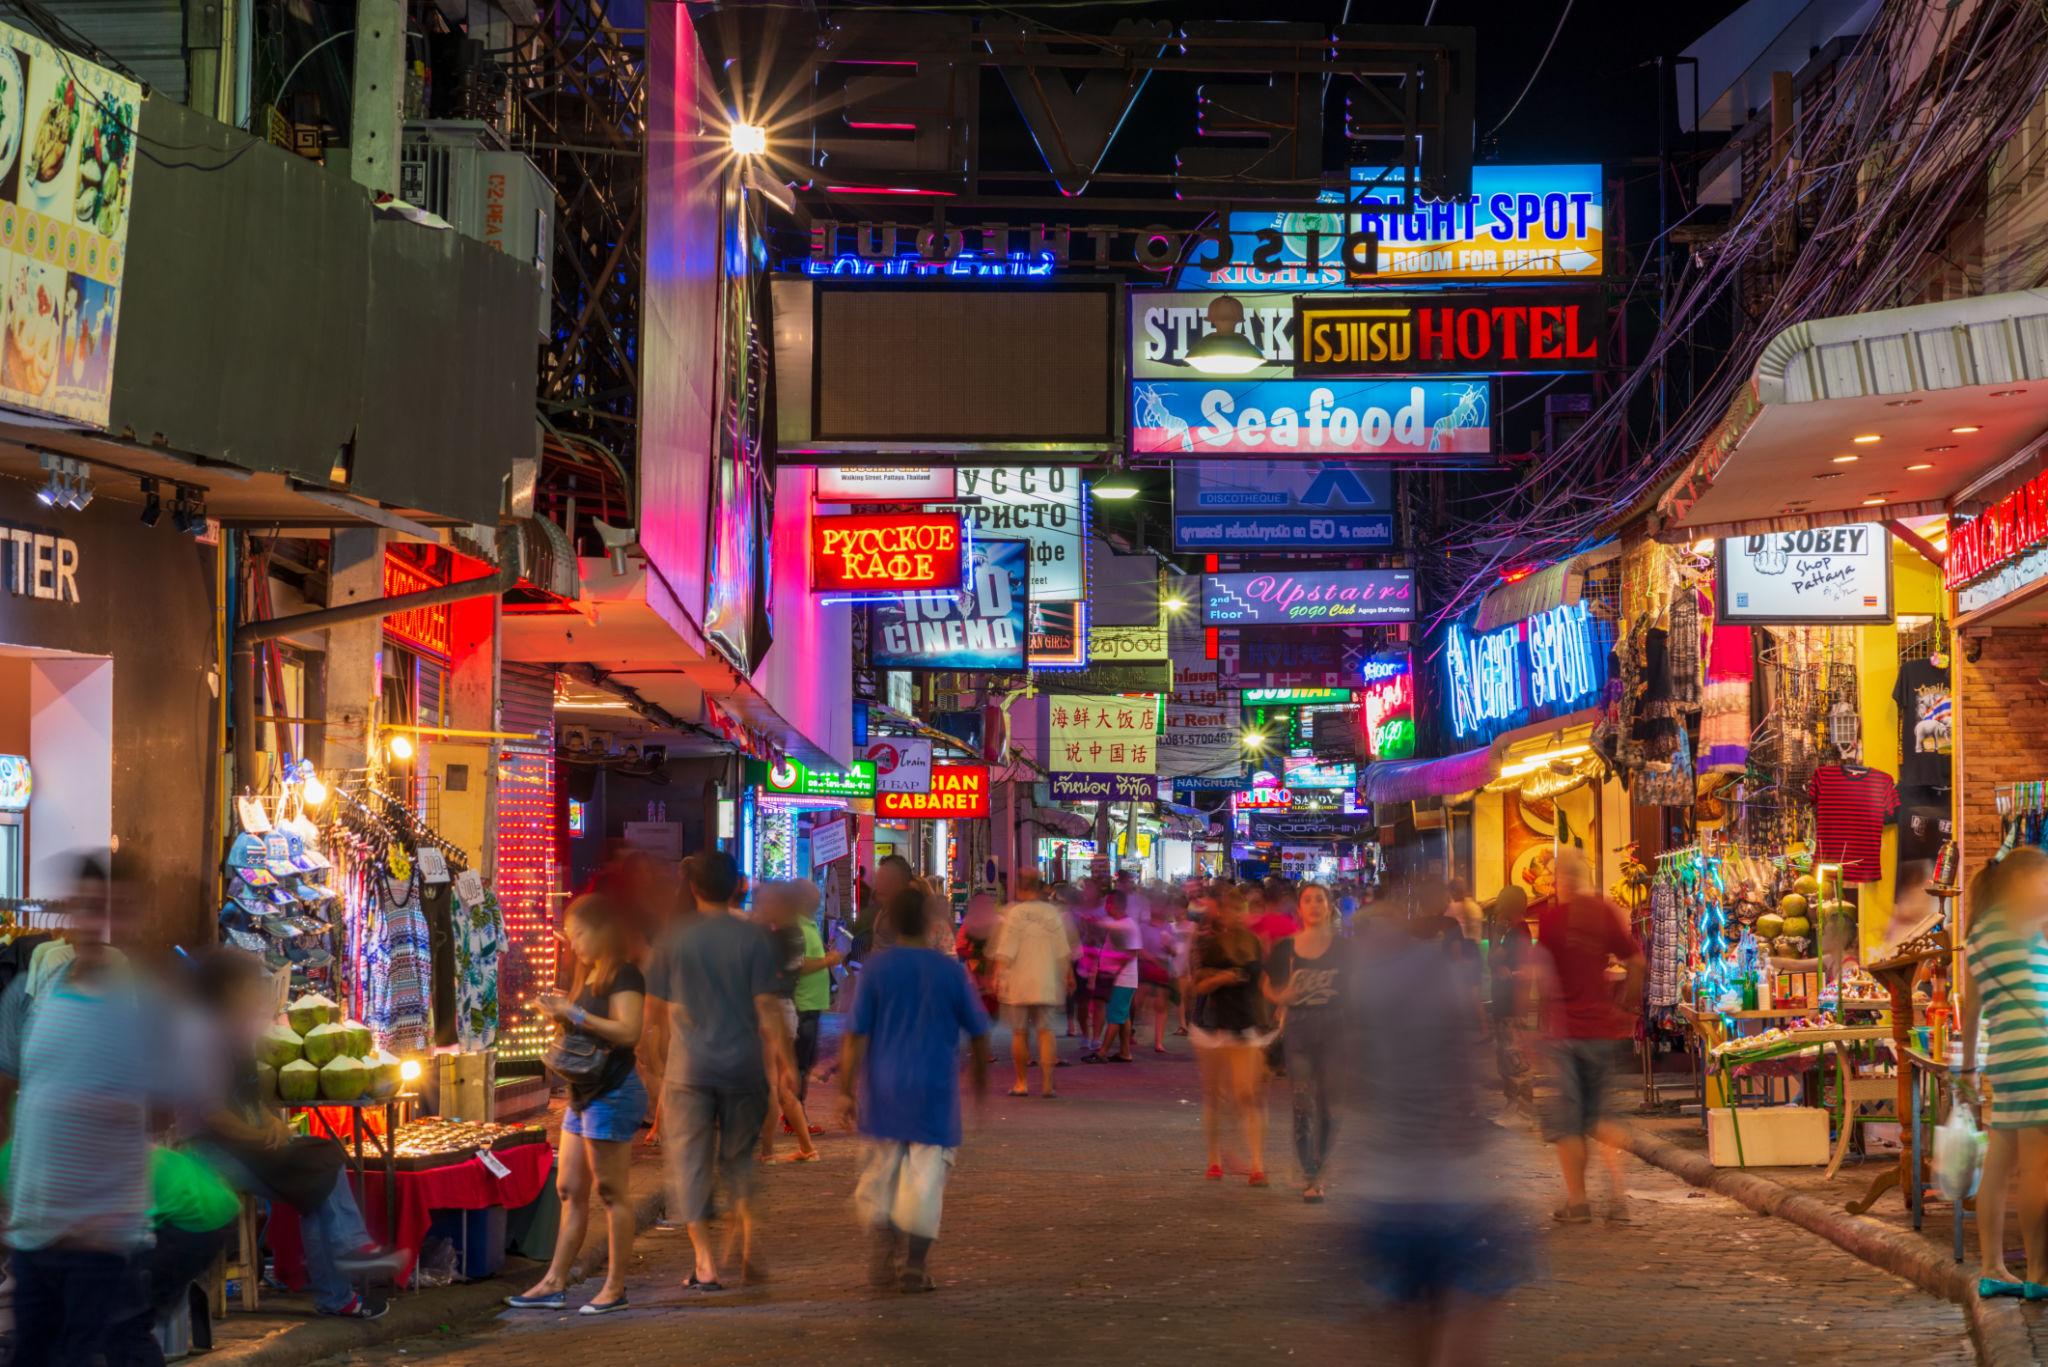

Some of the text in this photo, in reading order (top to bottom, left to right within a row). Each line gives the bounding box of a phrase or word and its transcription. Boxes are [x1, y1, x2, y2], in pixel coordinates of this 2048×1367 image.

[1361, 194, 1480, 241] RIGHT
[1489, 192, 1592, 240] SPOT
[1393, 249, 1558, 273] ROOM FOR RENT
[1418, 305, 1598, 360] HOTEL
[1198, 387, 1425, 447] Seafood
[1206, 493, 1282, 503] DISCOTHEQUE
[822, 525, 955, 554] РУССКОЕ
[1309, 519, 1336, 539] 50
[1339, 526, 1350, 538] %
[841, 553, 935, 581] КАФЕ
[1792, 563, 1856, 594] Pattaya
[1796, 557, 1832, 578] Shop
[1210, 596, 1229, 607] 2nd
[1247, 576, 1410, 611] Upstairs
[1210, 610, 1242, 619] Floor
[1329, 604, 1357, 616] Club
[884, 618, 1017, 654] CINEMA
[1045, 634, 1071, 649] GIRLS
[1052, 706, 1154, 730] 海鲜大饭店
[1185, 711, 1227, 727] Rent
[1065, 741, 1147, 764] 说中国话
[889, 780, 920, 789] БАР
[886, 794, 979, 810] CABARET
